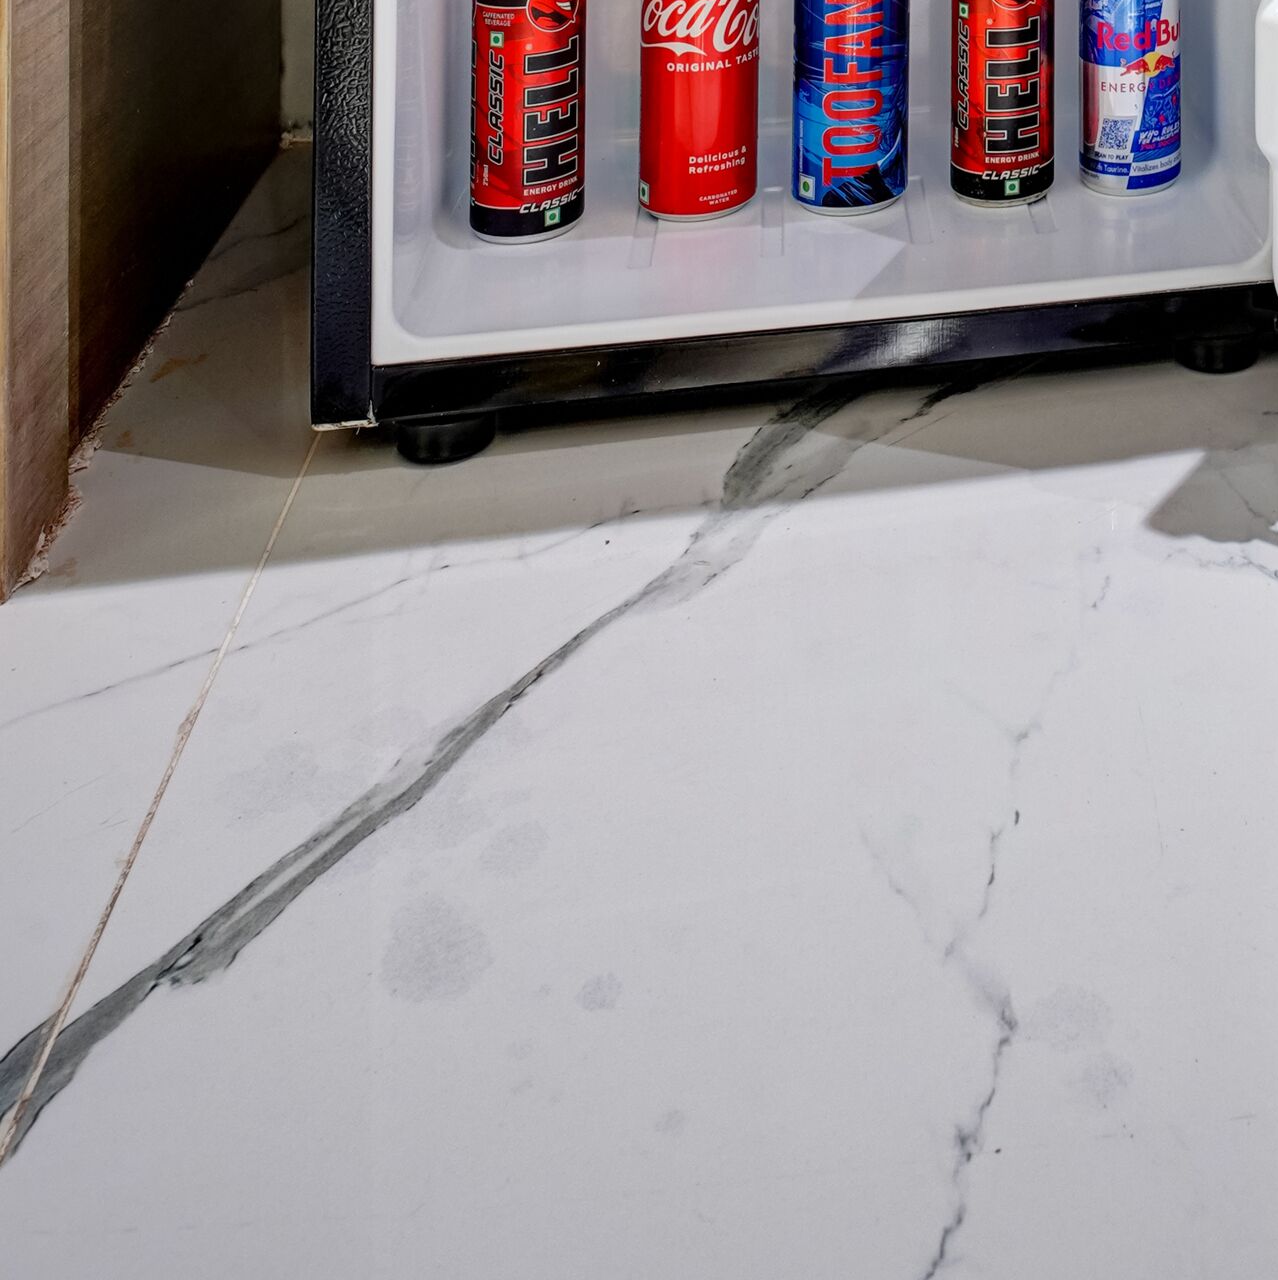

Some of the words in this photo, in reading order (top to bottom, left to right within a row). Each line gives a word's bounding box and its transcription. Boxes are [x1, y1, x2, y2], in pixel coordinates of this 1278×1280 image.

[1096, 19, 1152, 51] Red
[1156, 18, 1180, 47] Bu
[666, 59, 732, 73] ORIGINAL
[956, 18, 970, 131] CLASSIC
[984, 15, 1040, 154] HELL
[1101, 81, 1155, 93] ENERGY
[488, 49, 504, 166] CLASSIC
[522, 34, 579, 186] HELL
[688, 149, 739, 164] Delicious
[688, 157, 746, 175] Refreshing
[984, 156, 1017, 164] ENERGY
[1017, 151, 1040, 162] DRINK
[982, 164, 1041, 181] CLASSIC
[523, 184, 558, 197] ENERGY
[558, 176, 578, 189] DRINK
[519, 188, 579, 214] CLASSIC
